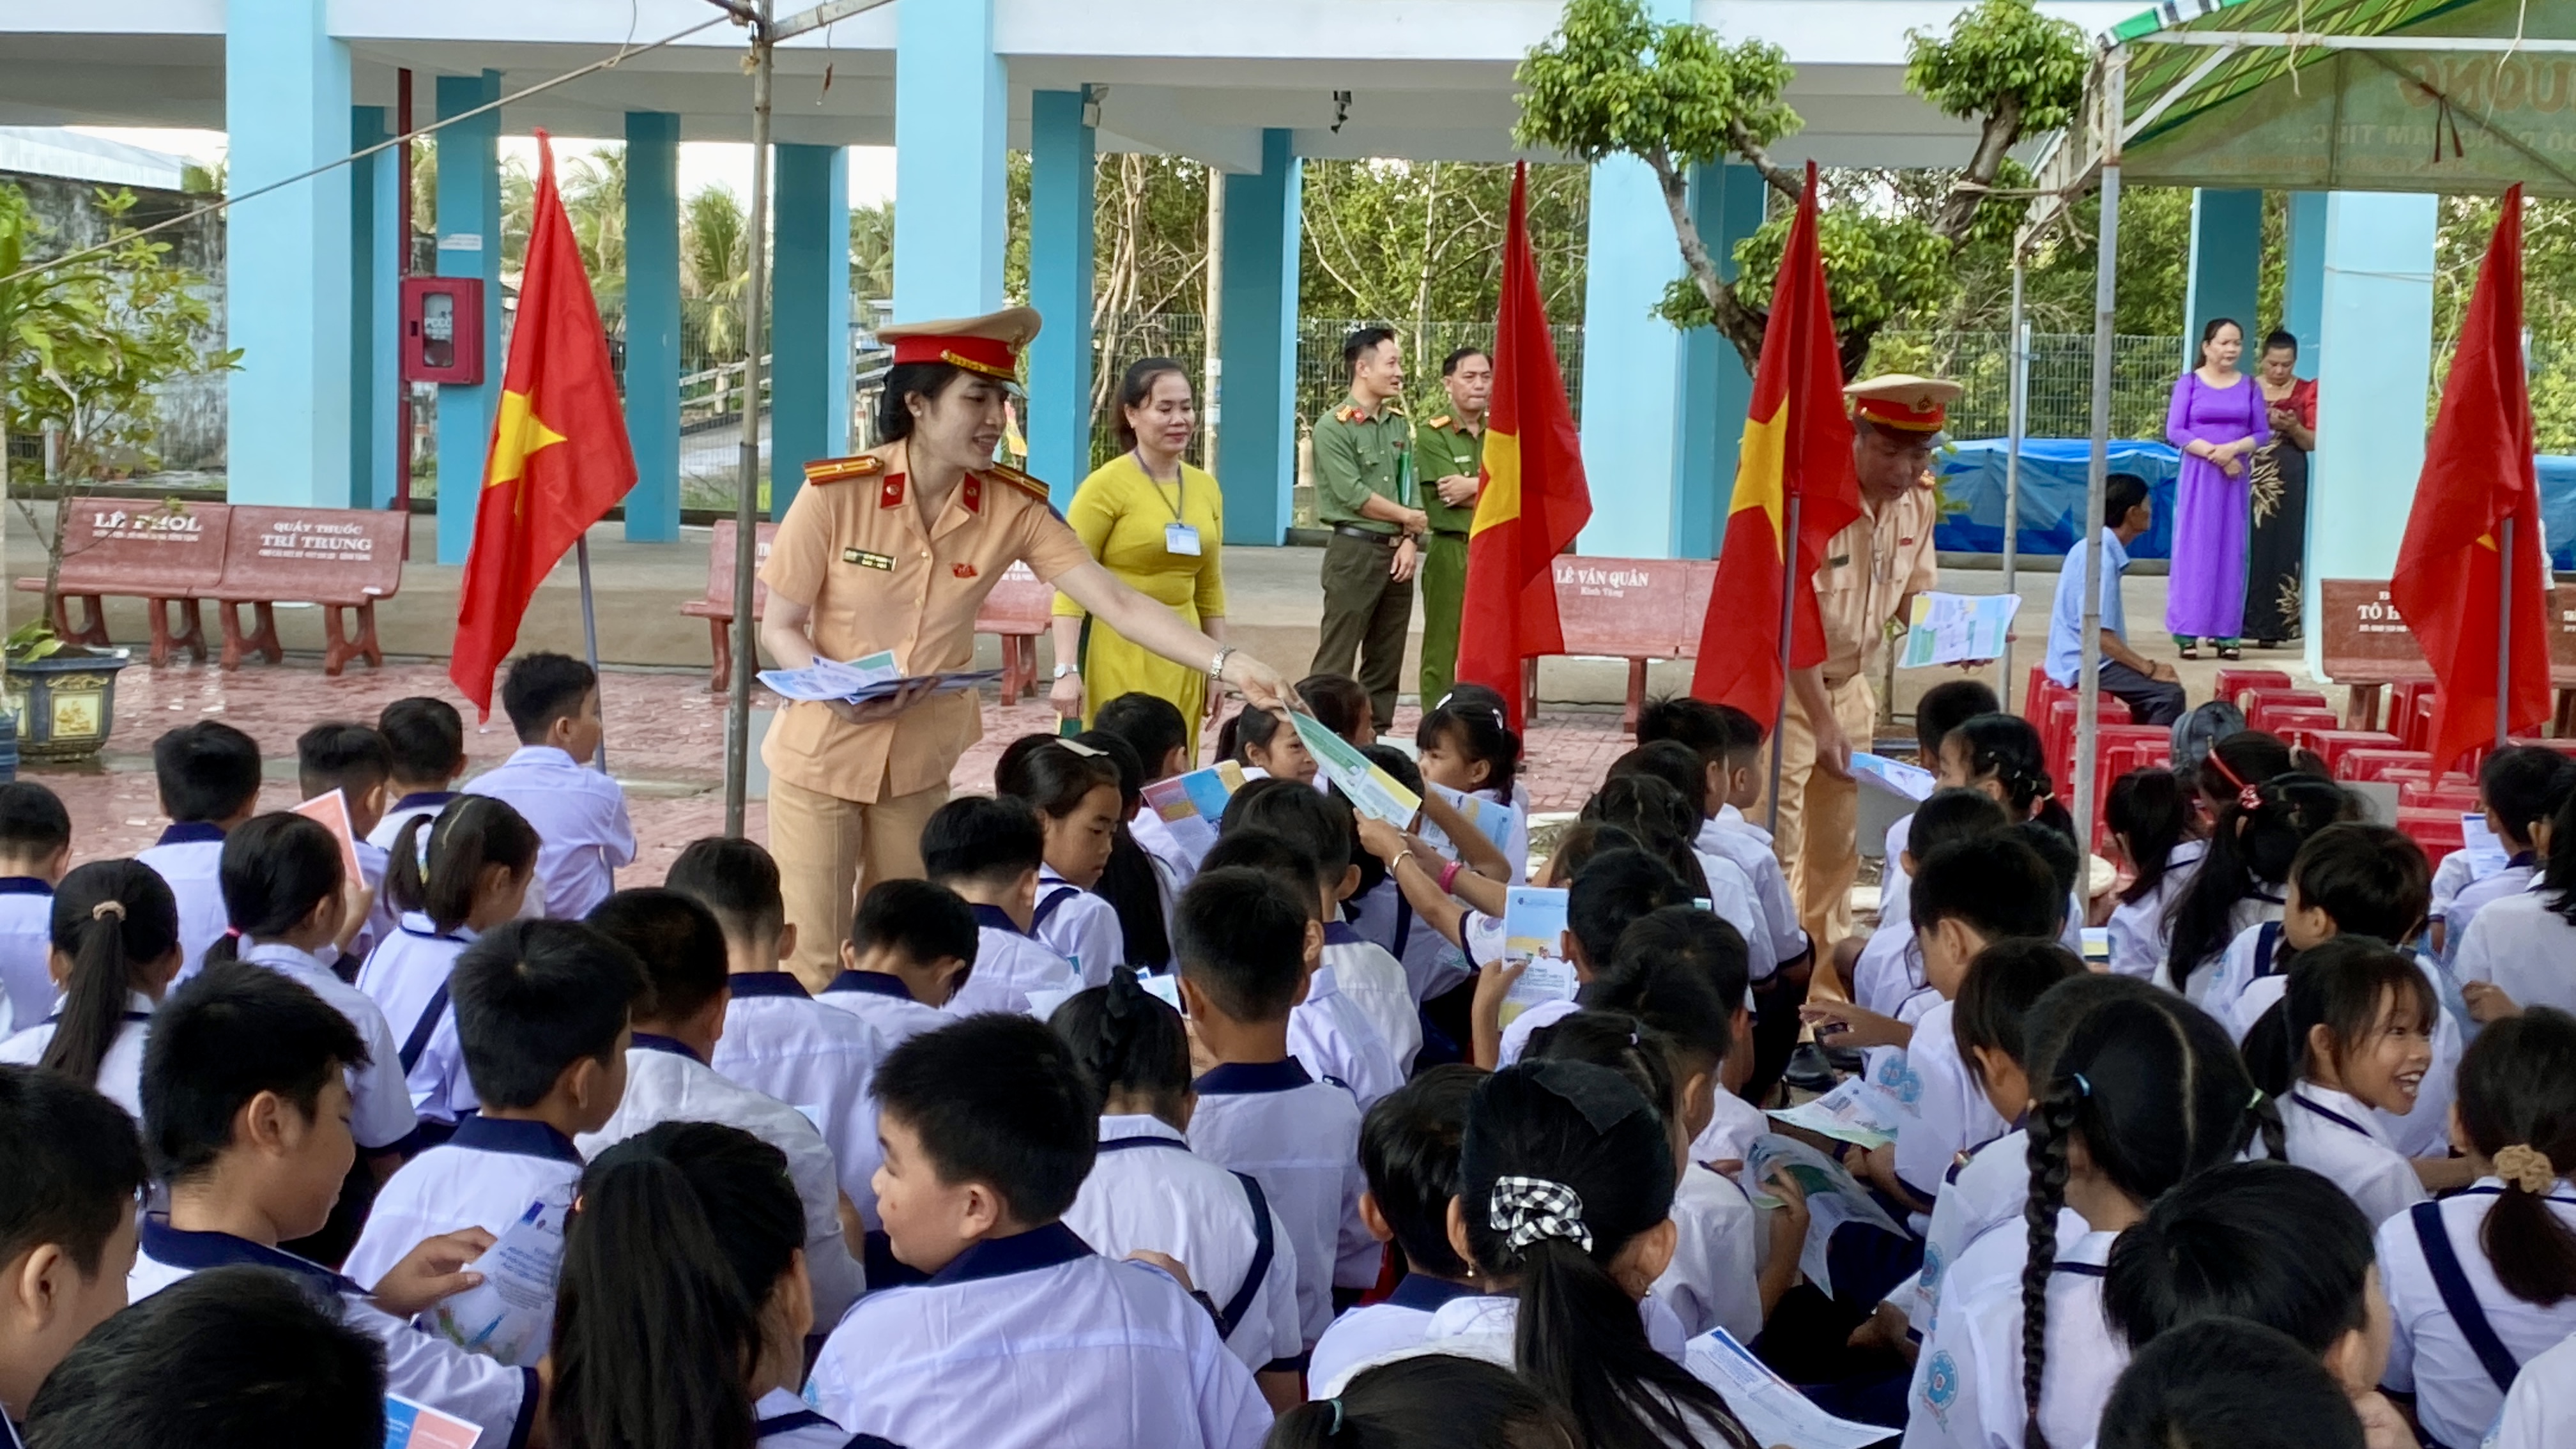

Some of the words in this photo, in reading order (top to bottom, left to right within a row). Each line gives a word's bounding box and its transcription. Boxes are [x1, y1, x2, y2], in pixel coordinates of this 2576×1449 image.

[261, 533, 296, 548] TRÍ
[301, 535, 372, 551] TRUNG
[1556, 566, 1574, 584] LÊ
